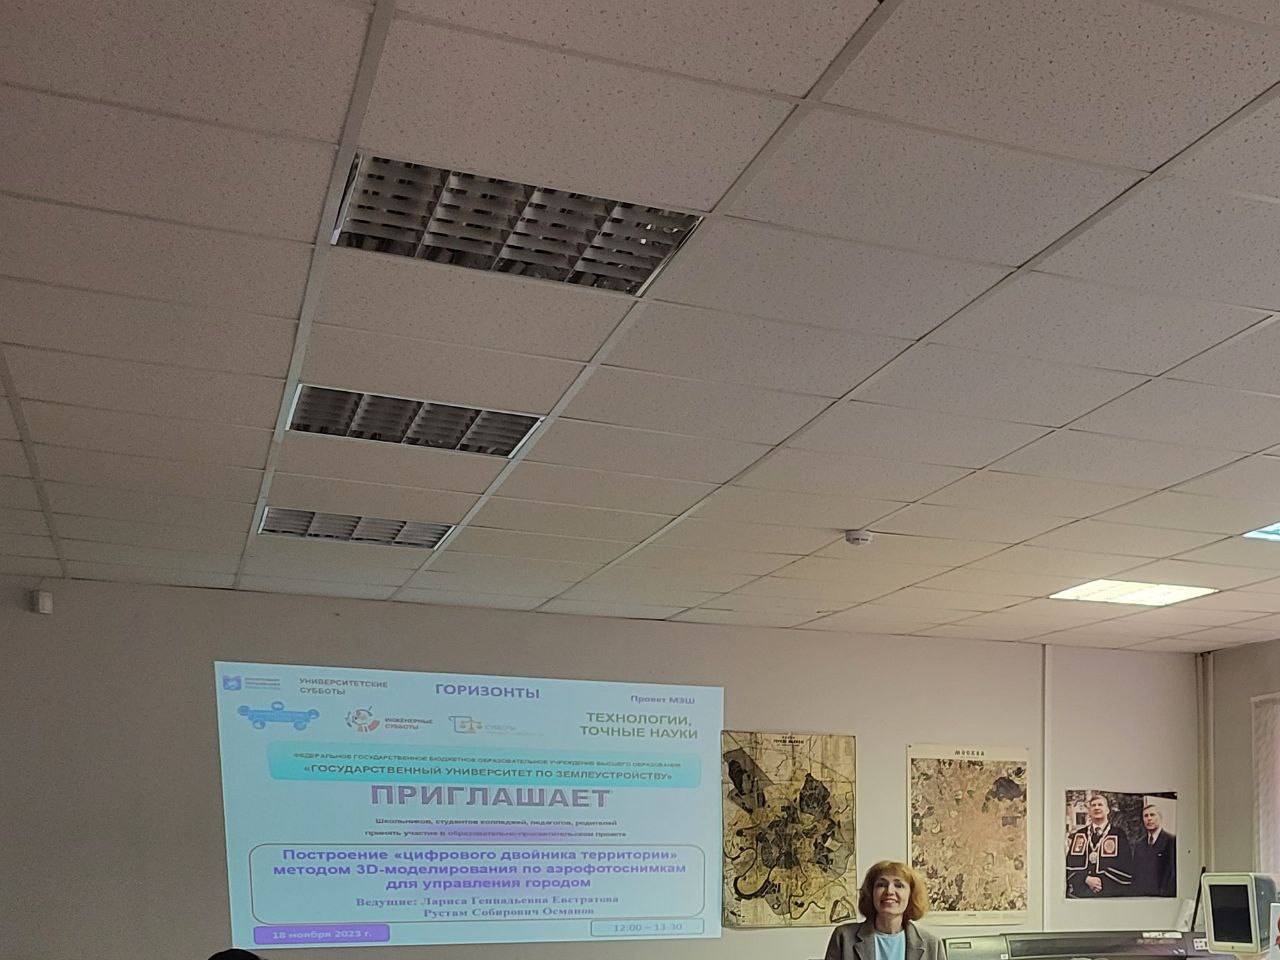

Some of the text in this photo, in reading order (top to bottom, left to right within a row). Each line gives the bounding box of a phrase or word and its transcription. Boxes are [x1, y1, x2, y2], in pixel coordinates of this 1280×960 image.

[299, 677, 388, 689] УНИВЕРСИТЕТСКИЕ
[299, 687, 346, 695] СУББОТЫ
[435, 683, 540, 699] ГОРИЗОНТЫ
[630, 694, 696, 705] Проект МЭШ
[586, 712, 693, 727] ТЕХНОЛОГИИ,
[580, 725, 698, 740] ТОЧНЫЕ НАУКИ
[304, 764, 673, 781] «ГОСУДАРСТВЕННЫЙ УНИВЕРСИТЕТ ПО ЗЕМЛЕУСТРОЙСТВУ»
[371, 785, 611, 807] ПРИГЛАШАЕТ
[282, 849, 678, 863] Построение «цифрового двойника территории»
[273, 863, 686, 876] методом 3D-моделирования по аэрофотоснимкам
[385, 878, 592, 891] для управления городом
[356, 895, 619, 908] Ведущие: Лариса Геннадьевна Евстратова
[424, 906, 595, 918] Рустам Собирович Османов
[614, 923, 643, 932] 12:00
[272, 931, 287, 939] 18
[288, 930, 332, 940] ноября
[334, 929, 362, 938] 2023
